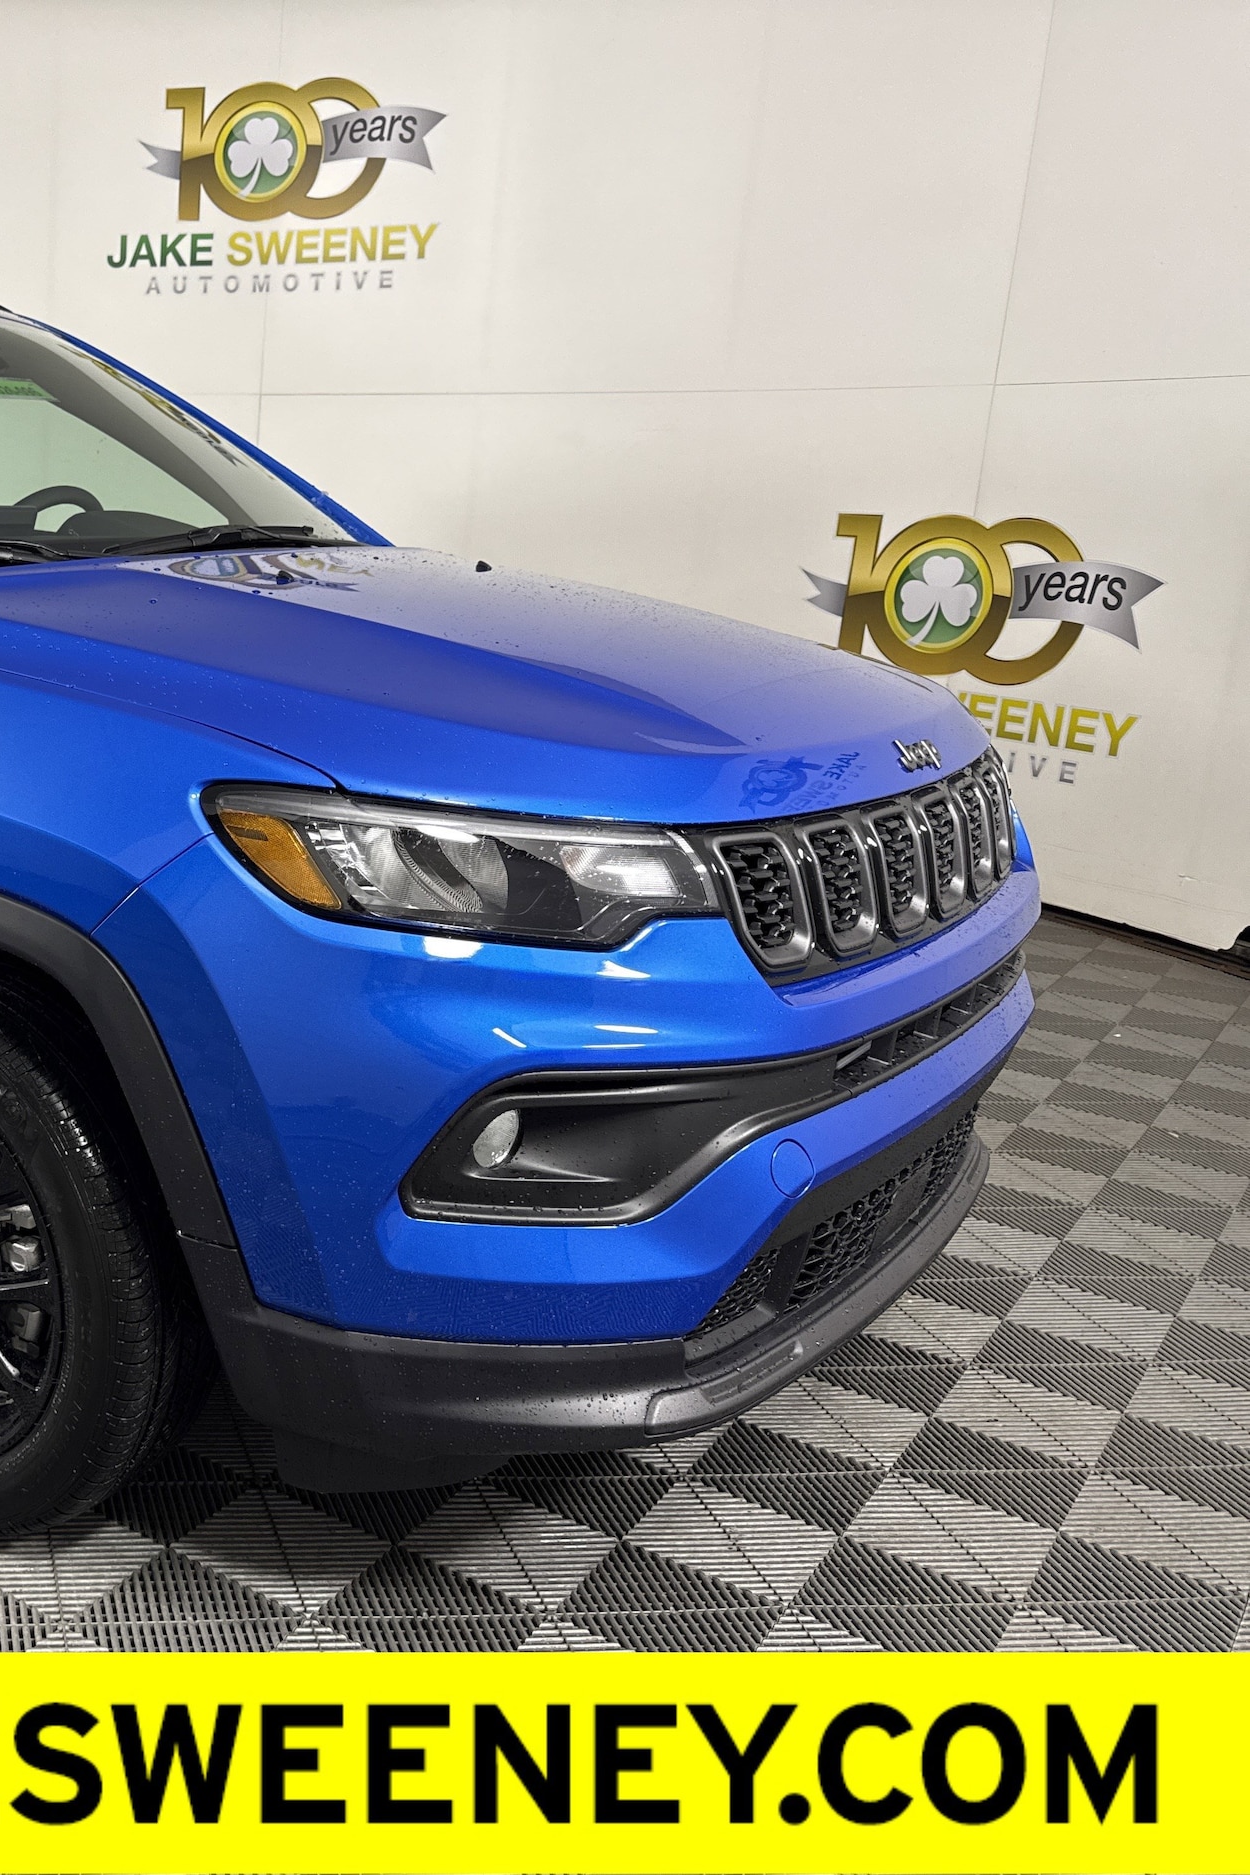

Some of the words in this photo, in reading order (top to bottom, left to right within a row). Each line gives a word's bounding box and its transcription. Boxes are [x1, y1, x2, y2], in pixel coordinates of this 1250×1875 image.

[165, 77, 387, 221] 100
[329, 112, 417, 156] years
[106, 233, 214, 268] JAKE
[226, 223, 438, 267] SWEENEY
[145, 270, 395, 295] AUTOMOTIVE
[1017, 570, 1126, 611] years
